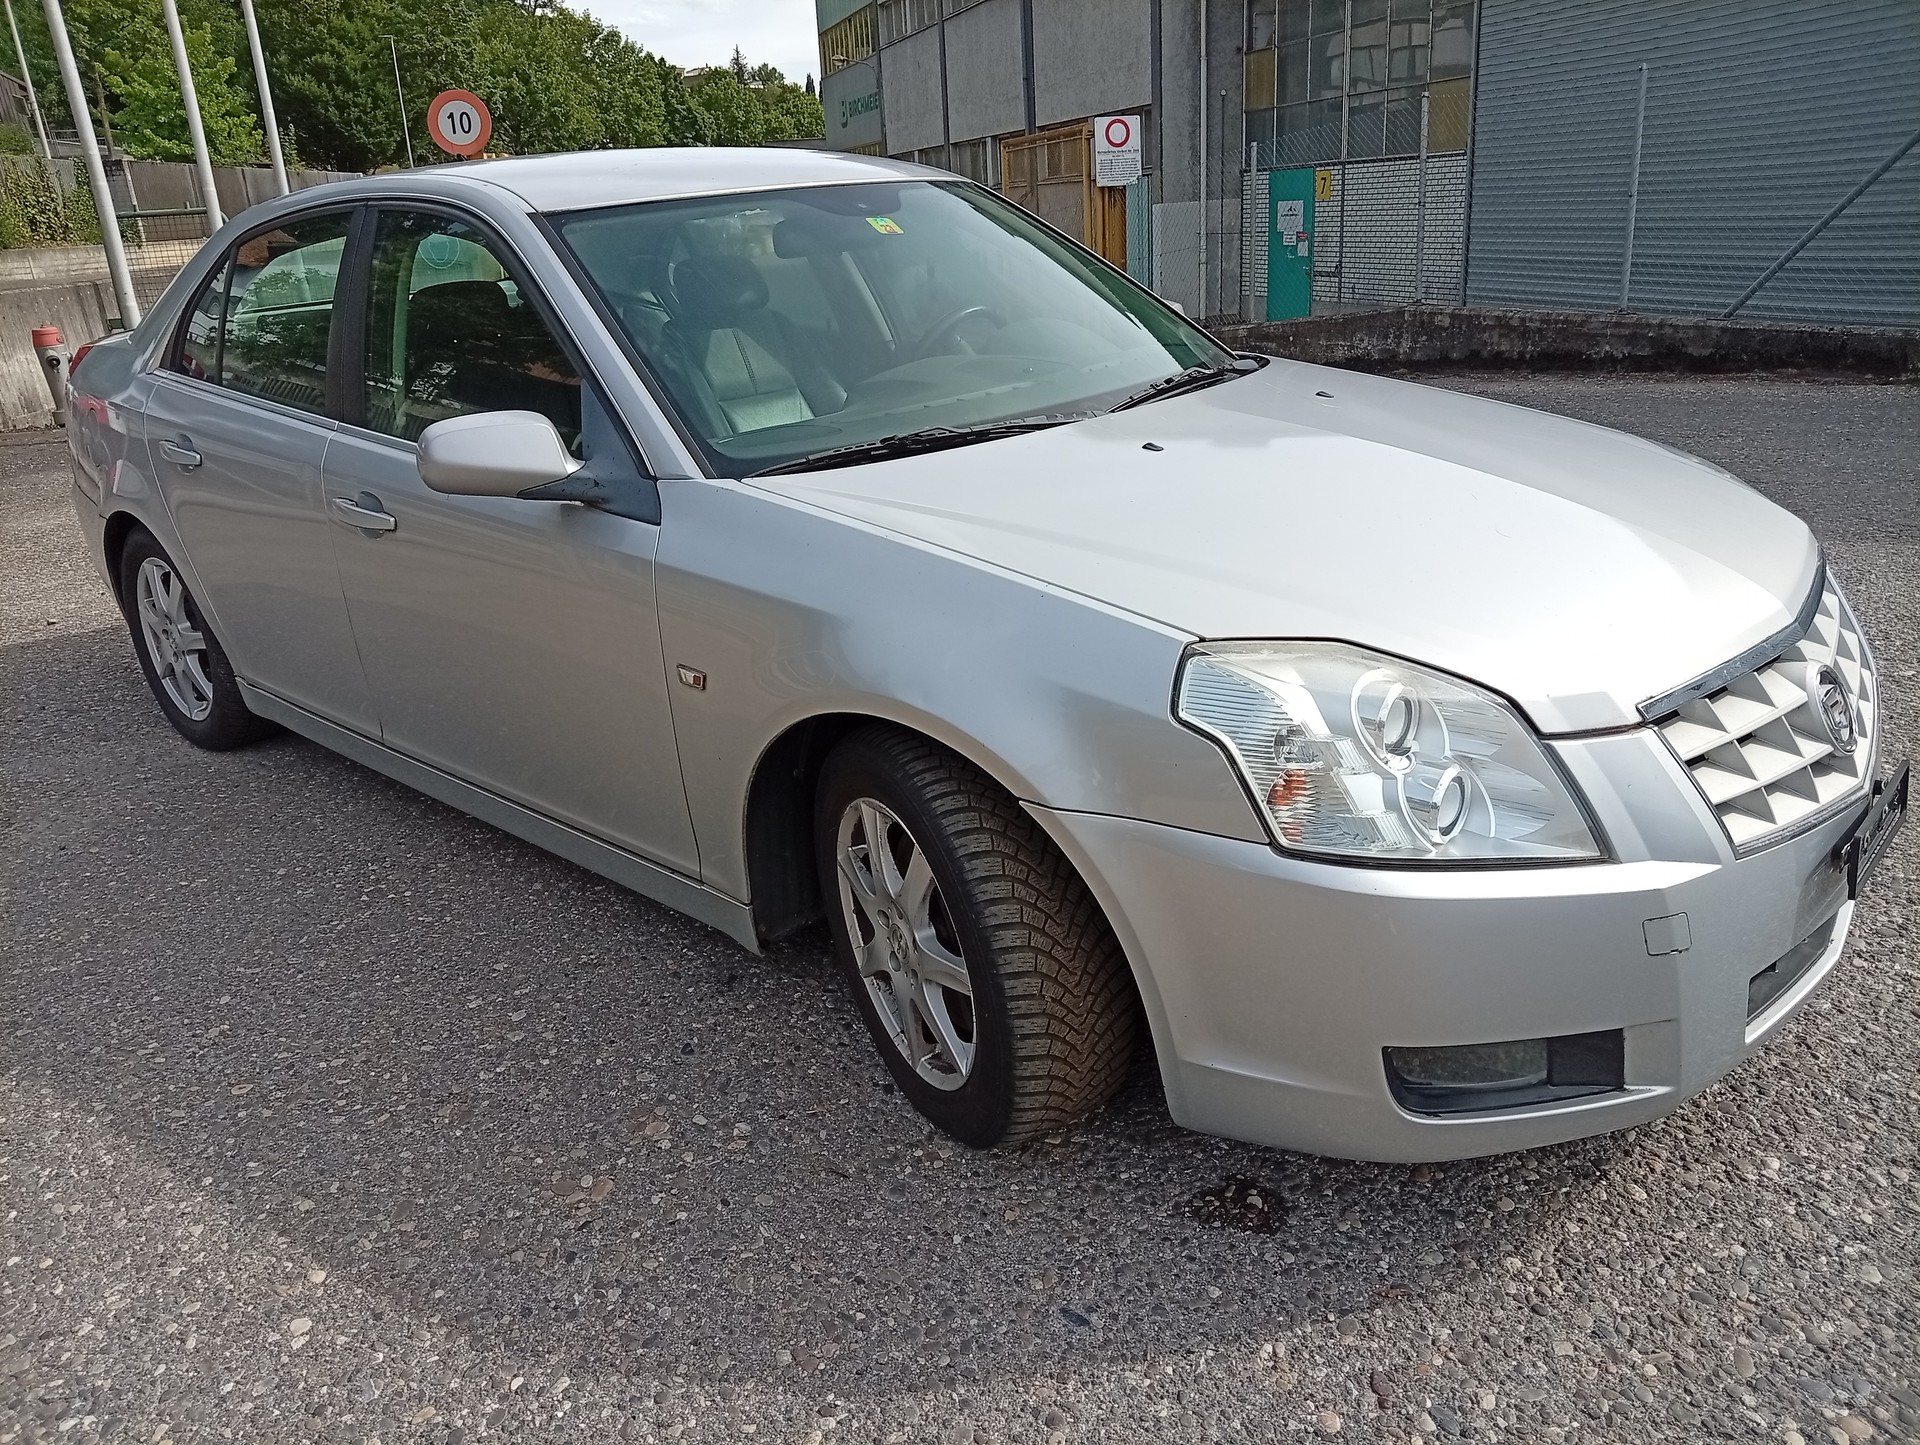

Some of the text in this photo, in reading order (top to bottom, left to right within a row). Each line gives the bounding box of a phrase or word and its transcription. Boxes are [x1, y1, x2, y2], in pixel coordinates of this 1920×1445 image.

[849, 91, 881, 118] BIRCHMEIE
[446, 111, 472, 135] 10
[1320, 176, 1327, 195] 7
